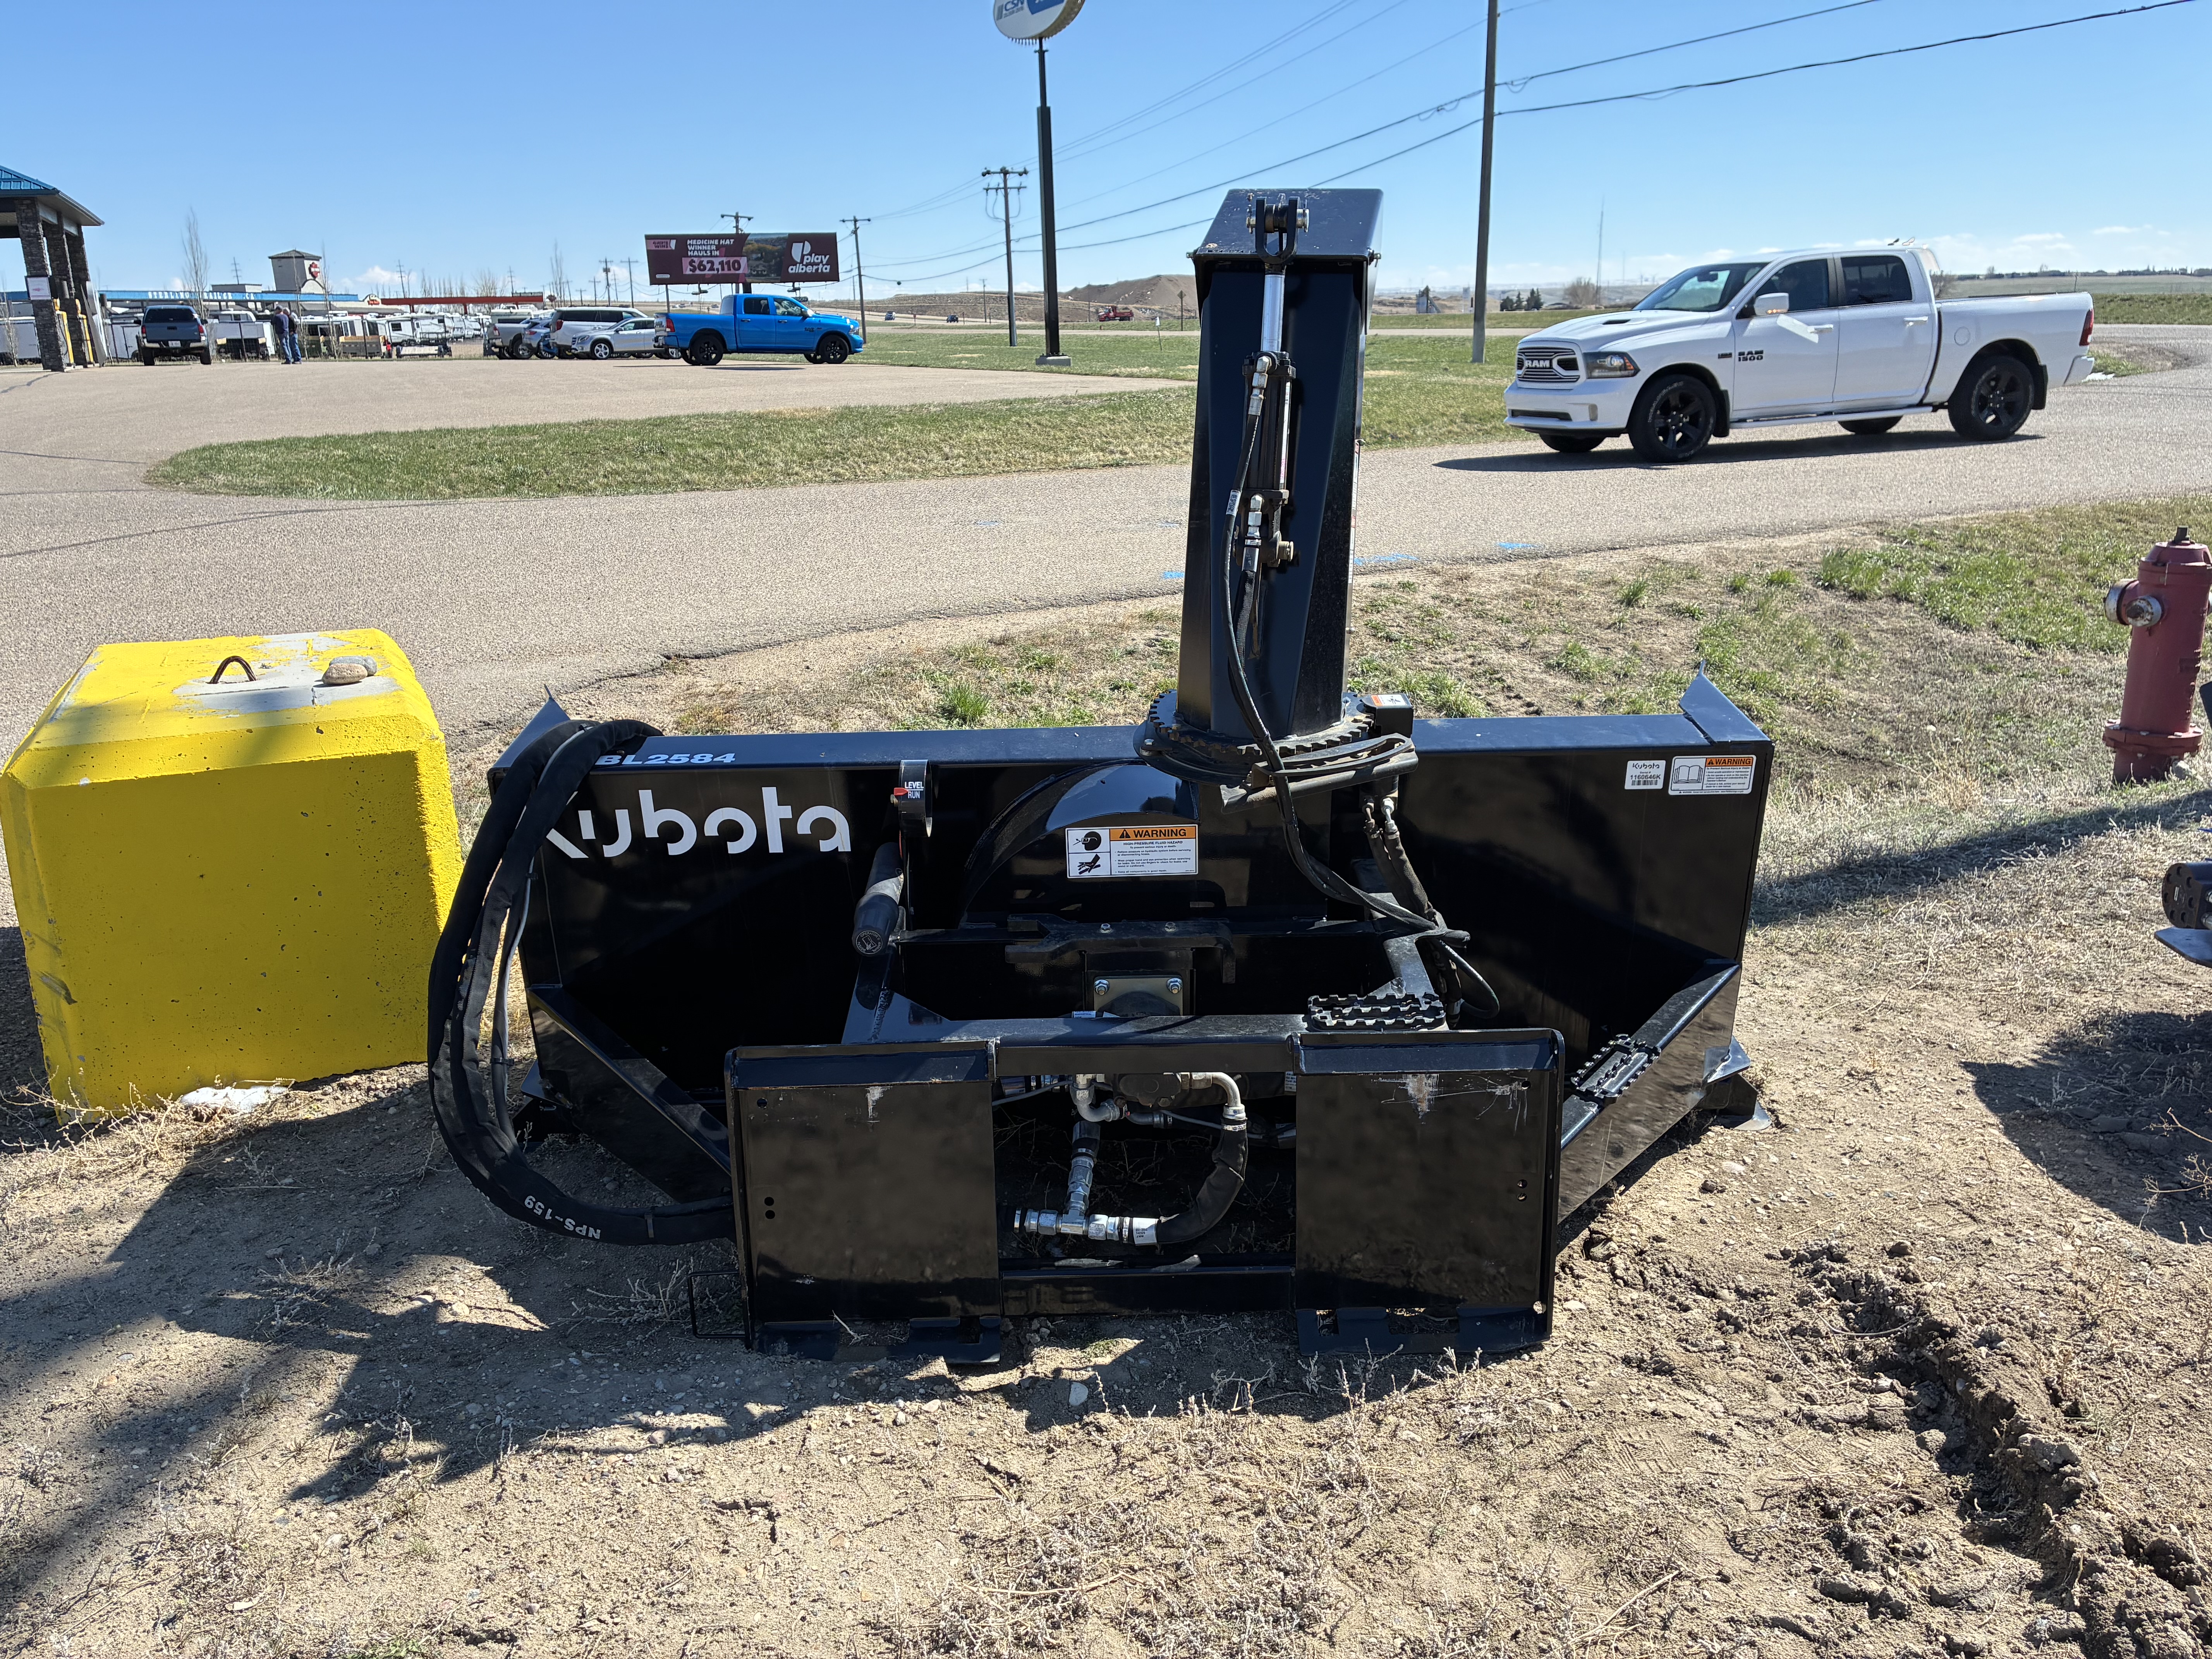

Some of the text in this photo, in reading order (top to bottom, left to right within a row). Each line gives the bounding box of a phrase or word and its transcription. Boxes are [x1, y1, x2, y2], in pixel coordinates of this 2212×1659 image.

[803, 253, 830, 264] play
[688, 258, 741, 273] $62,110
[788, 263, 830, 273] alberta
[1525, 360, 1550, 368] RAM
[1133, 828, 1187, 838] WARNING
[524, 1195, 601, 1239] NPS-159
